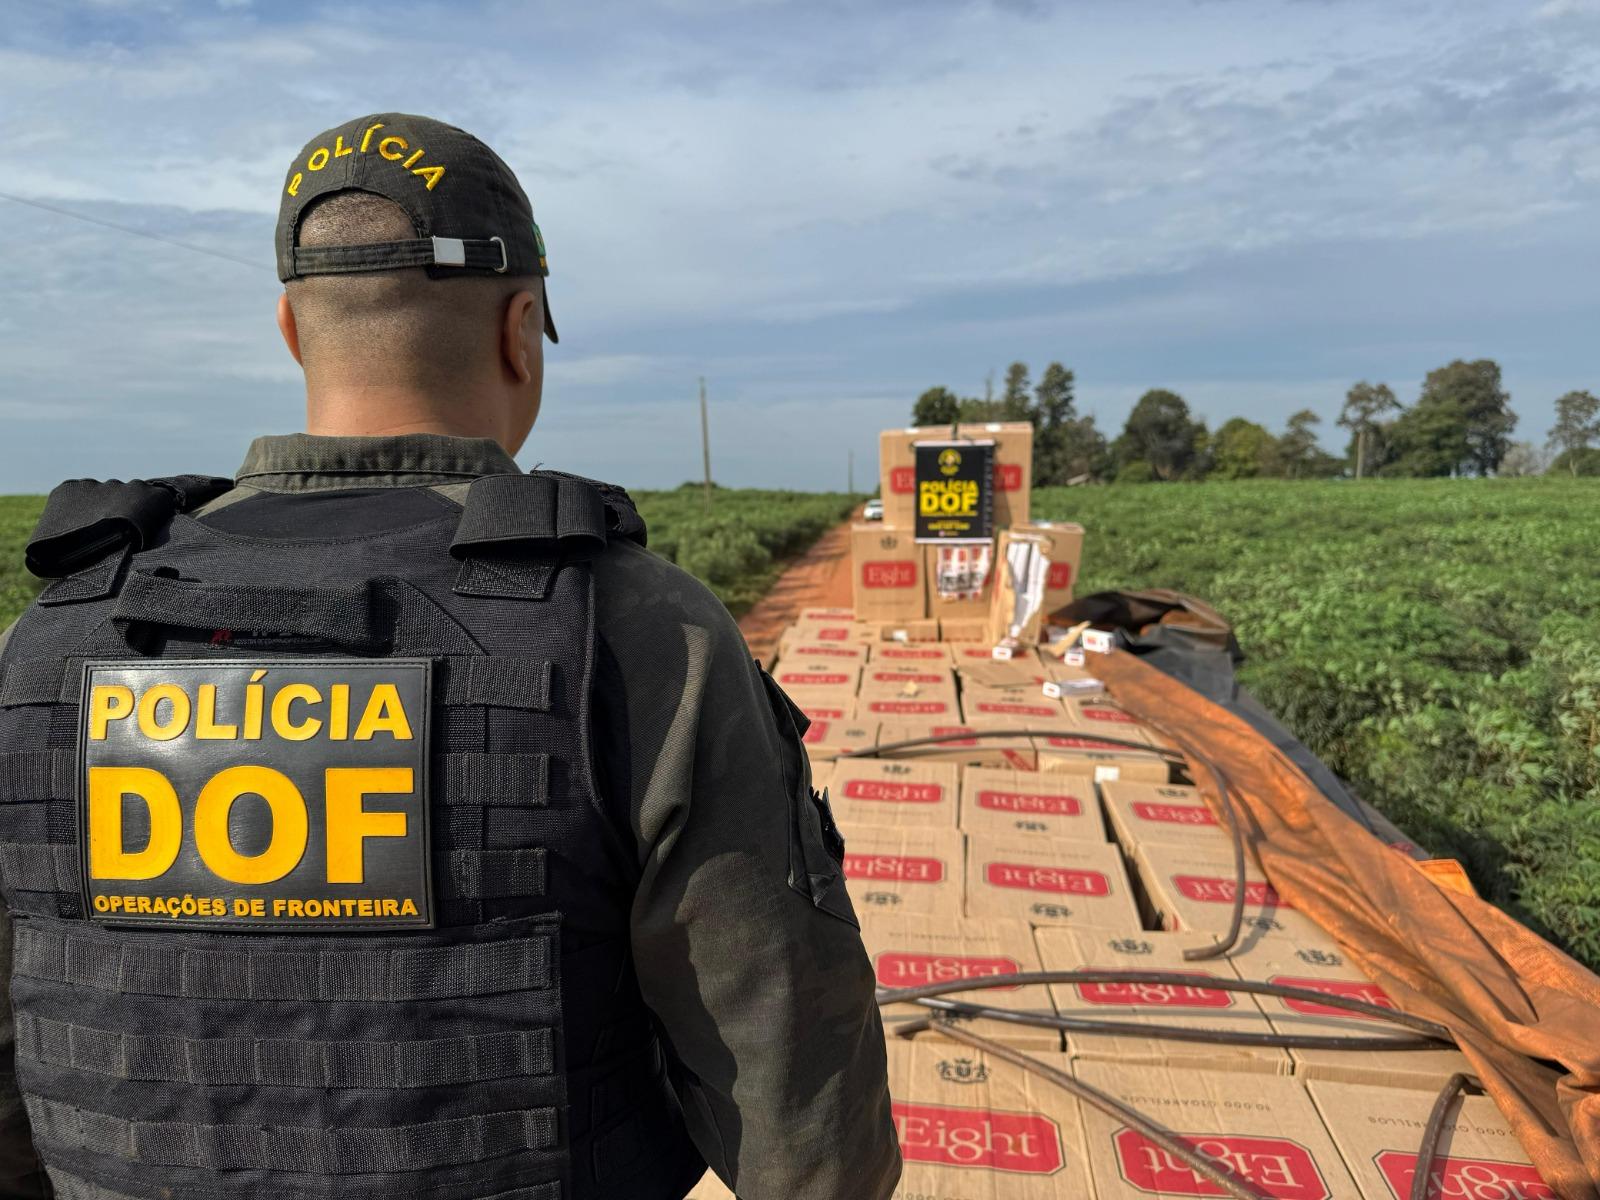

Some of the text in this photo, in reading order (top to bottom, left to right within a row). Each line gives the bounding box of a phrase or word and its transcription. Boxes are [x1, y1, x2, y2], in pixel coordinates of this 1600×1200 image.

[287, 123, 446, 197] POLÍCIA
[920, 479, 978, 493] POLÍCIA
[920, 493, 977, 512] DOF
[89, 669, 414, 742] POLÍCIA
[856, 784, 932, 800] Eight
[990, 794, 1070, 813] Eight
[88, 765, 414, 885] DOF
[1002, 868, 1096, 892] Eight
[94, 894, 419, 919] OPERAÇÕES DE FRONTEIRA
[897, 1115, 1040, 1163] Eight
